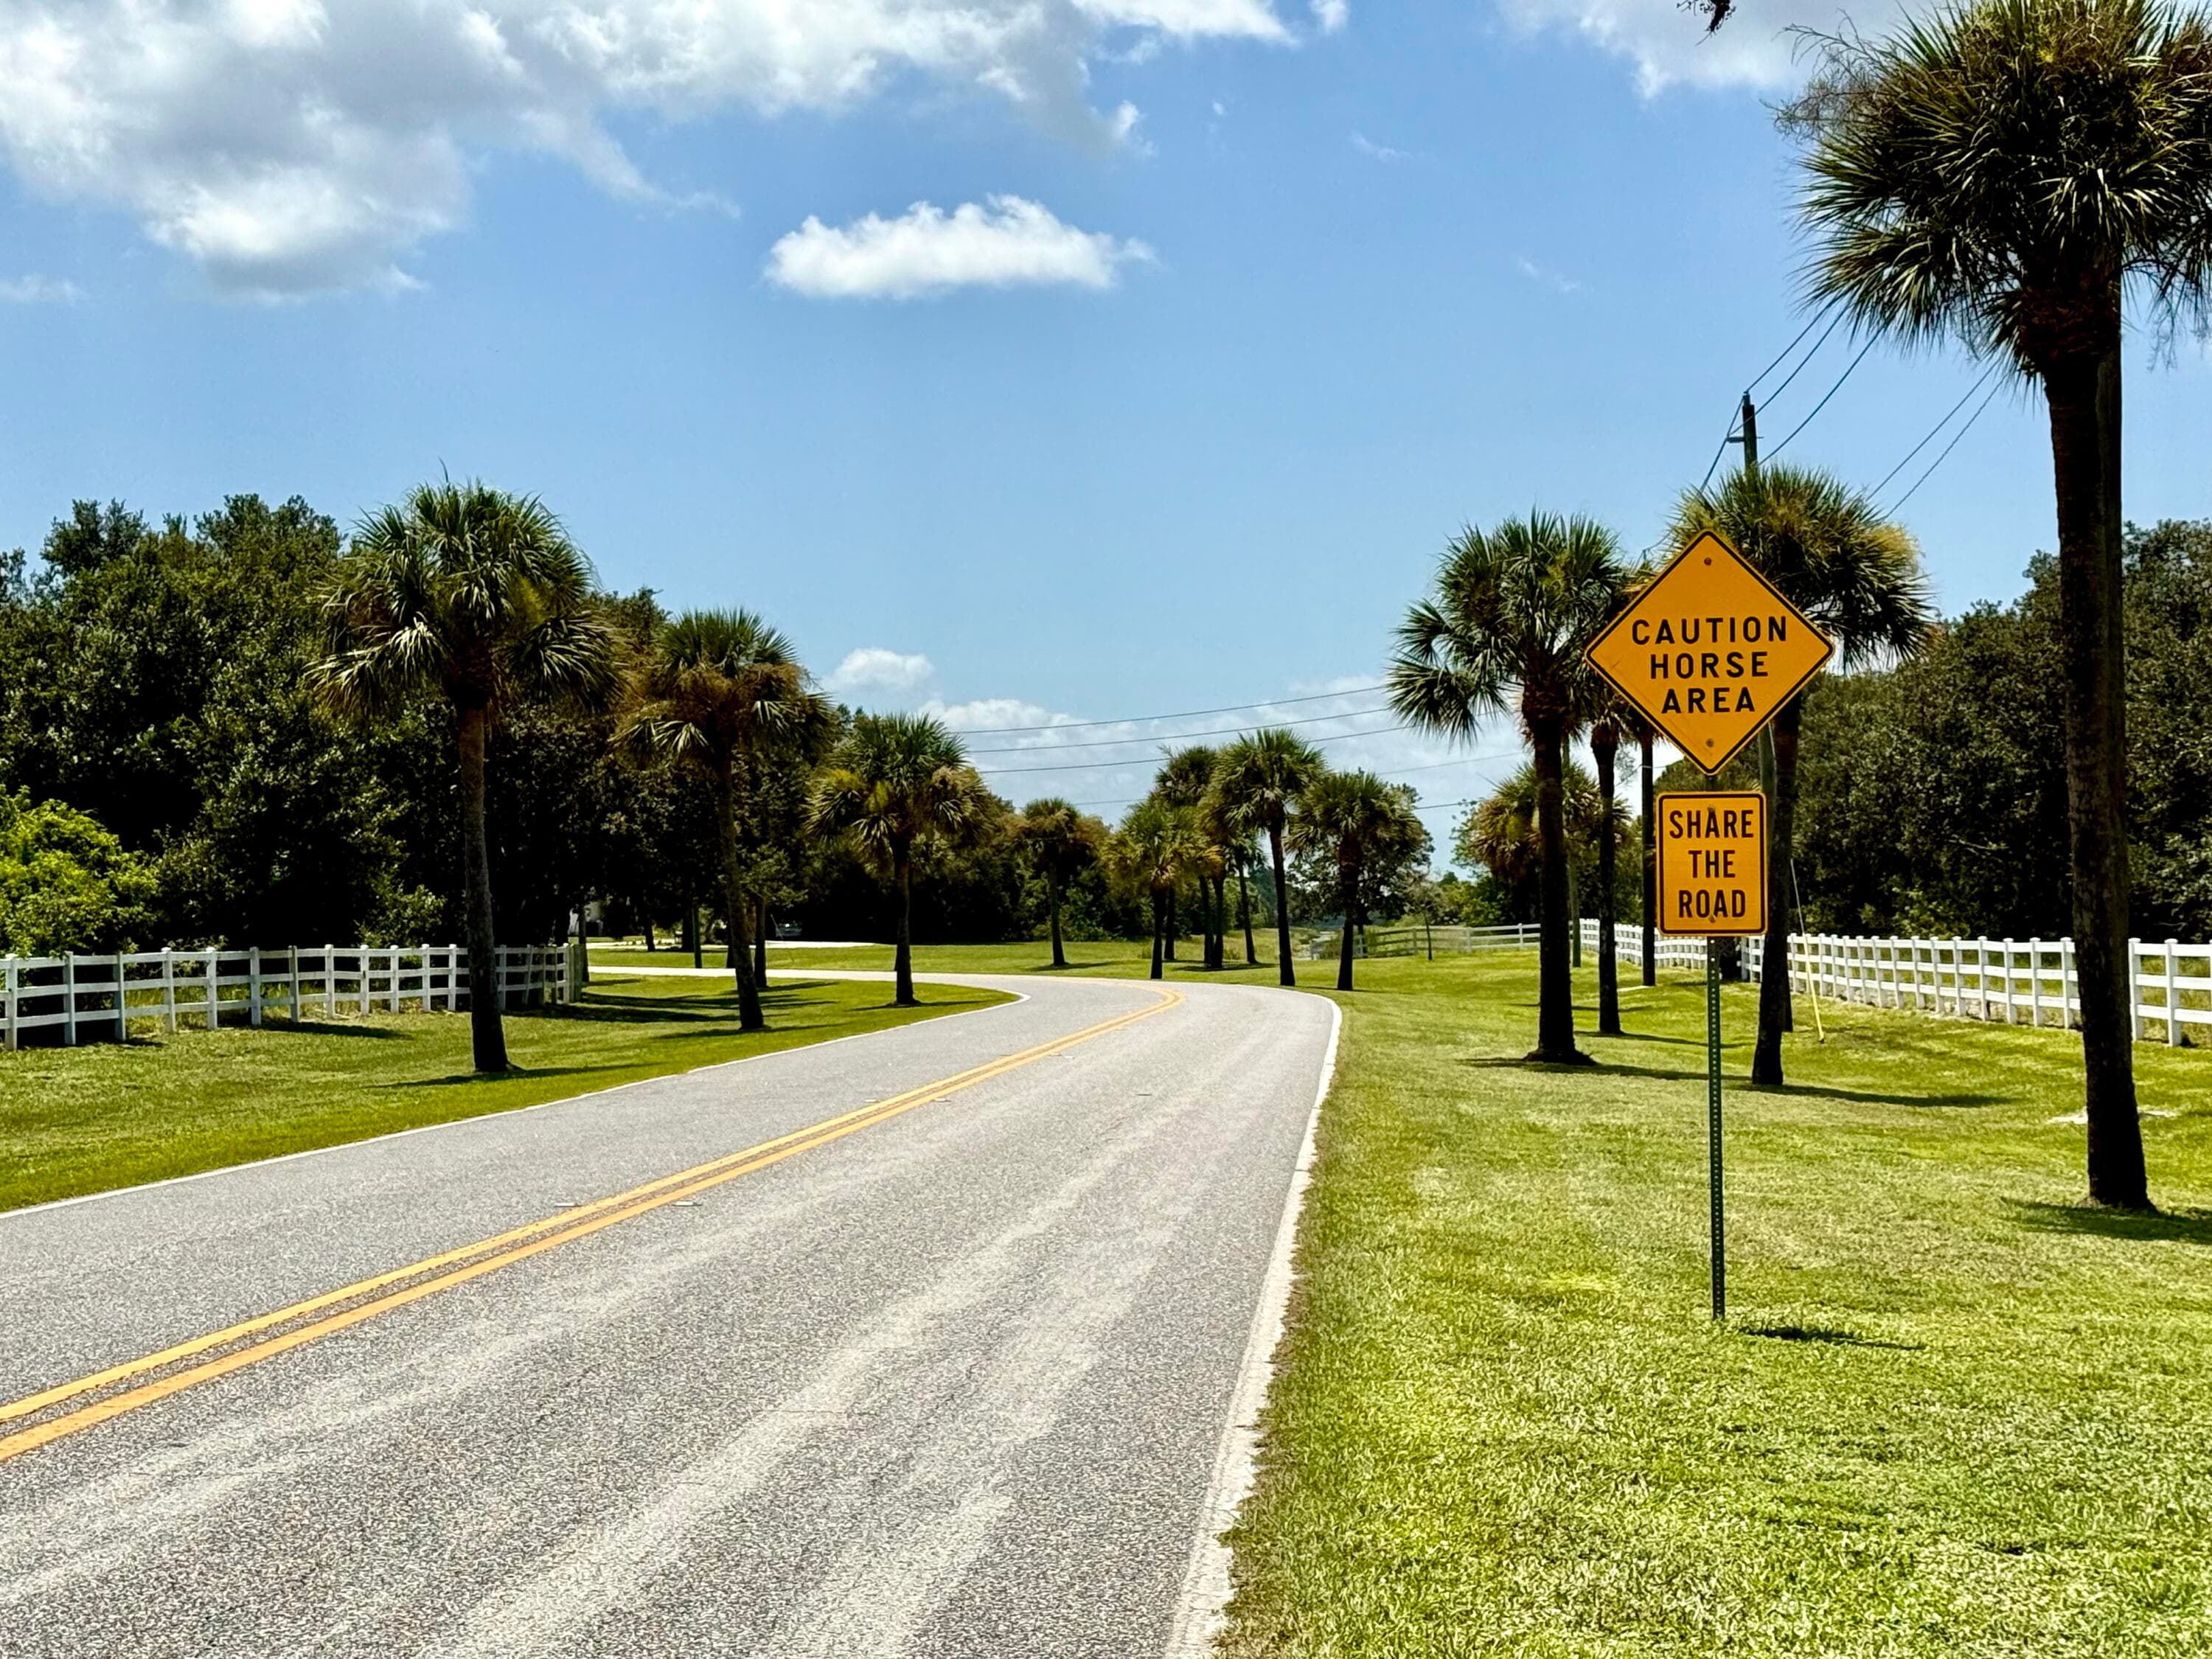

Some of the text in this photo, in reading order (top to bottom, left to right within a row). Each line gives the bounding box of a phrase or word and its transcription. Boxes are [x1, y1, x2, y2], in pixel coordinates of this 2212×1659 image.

[1632, 616, 1787, 645] CAUTION
[1650, 651, 1768, 680] HORSE
[1661, 686, 1755, 714] AREA
[1669, 809, 1754, 839] SHARE
[1688, 849, 1736, 878] THE
[1678, 889, 1746, 919] ROAD
